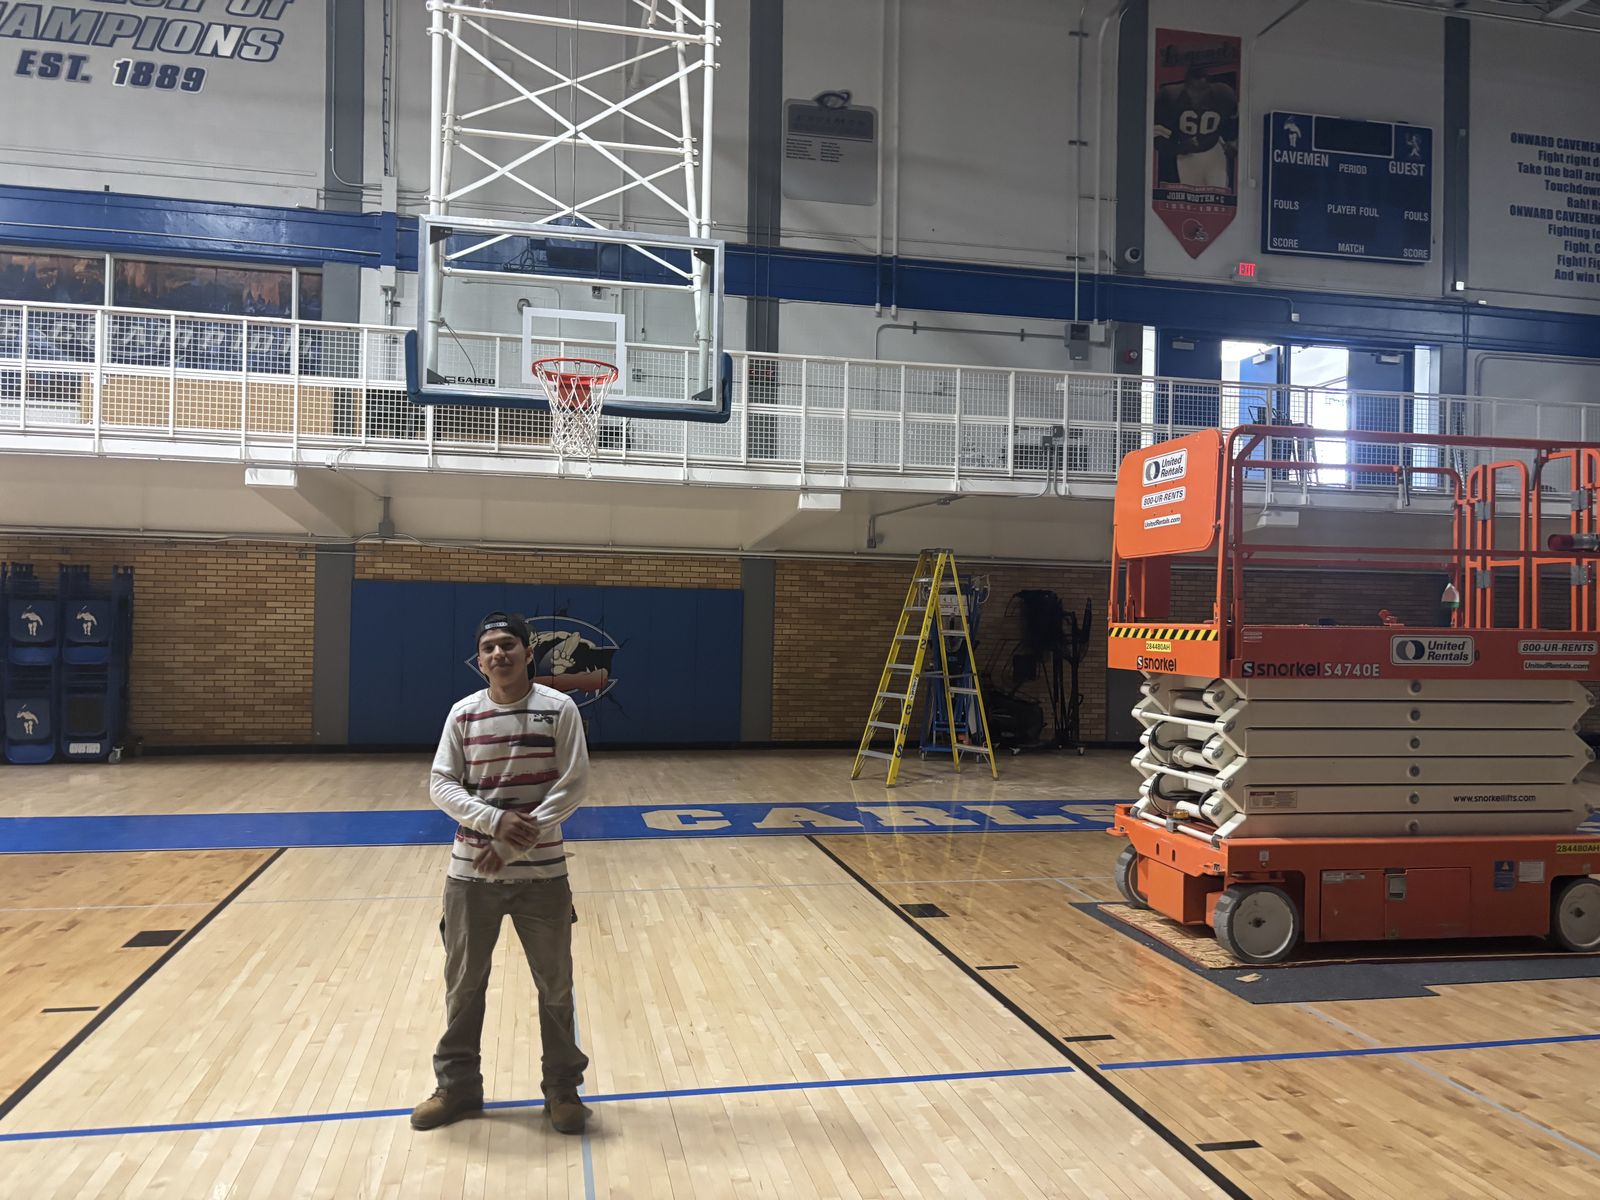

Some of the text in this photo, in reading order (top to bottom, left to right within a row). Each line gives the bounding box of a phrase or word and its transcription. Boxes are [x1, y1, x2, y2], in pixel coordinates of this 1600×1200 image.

[0, 2, 285, 62] AMPIONS
[15, 49, 207, 94] EST. 1889
[1179, 110, 1221, 135] 60
[1511, 132, 1555, 148] ONWARD
[1273, 149, 1425, 176] CAVEMEN GUEST
[1538, 150, 1600, 168] Fight right d
[1338, 163, 1367, 175] PERIOD
[1517, 162, 1542, 175] Take
[1544, 165, 1561, 177] the
[1563, 167, 1583, 180] ball
[1273, 200, 1429, 222] FOULS PLAYER FOUL FOULS
[1509, 204, 1553, 220] ONWARD
[1592, 199, 1600, 210] R
[1548, 224, 1590, 240] Fighting
[1272, 237, 1429, 259] SCORE MATCH SCORE
[1557, 255, 1586, 271] Fight!
[1554, 269, 1574, 281] And
[1576, 272, 1595, 284] win
[458, 376, 496, 385] GARED
[1161, 455, 1182, 468] United
[1160, 465, 1184, 479] Rentals
[1427, 640, 1465, 651] United
[1522, 643, 1594, 652] 800-UR-RENTS
[1144, 657, 1177, 671] snorkel
[1427, 651, 1469, 662] Rentals
[1257, 662, 1320, 676] snorkel
[1324, 663, 1380, 676] S4740E
